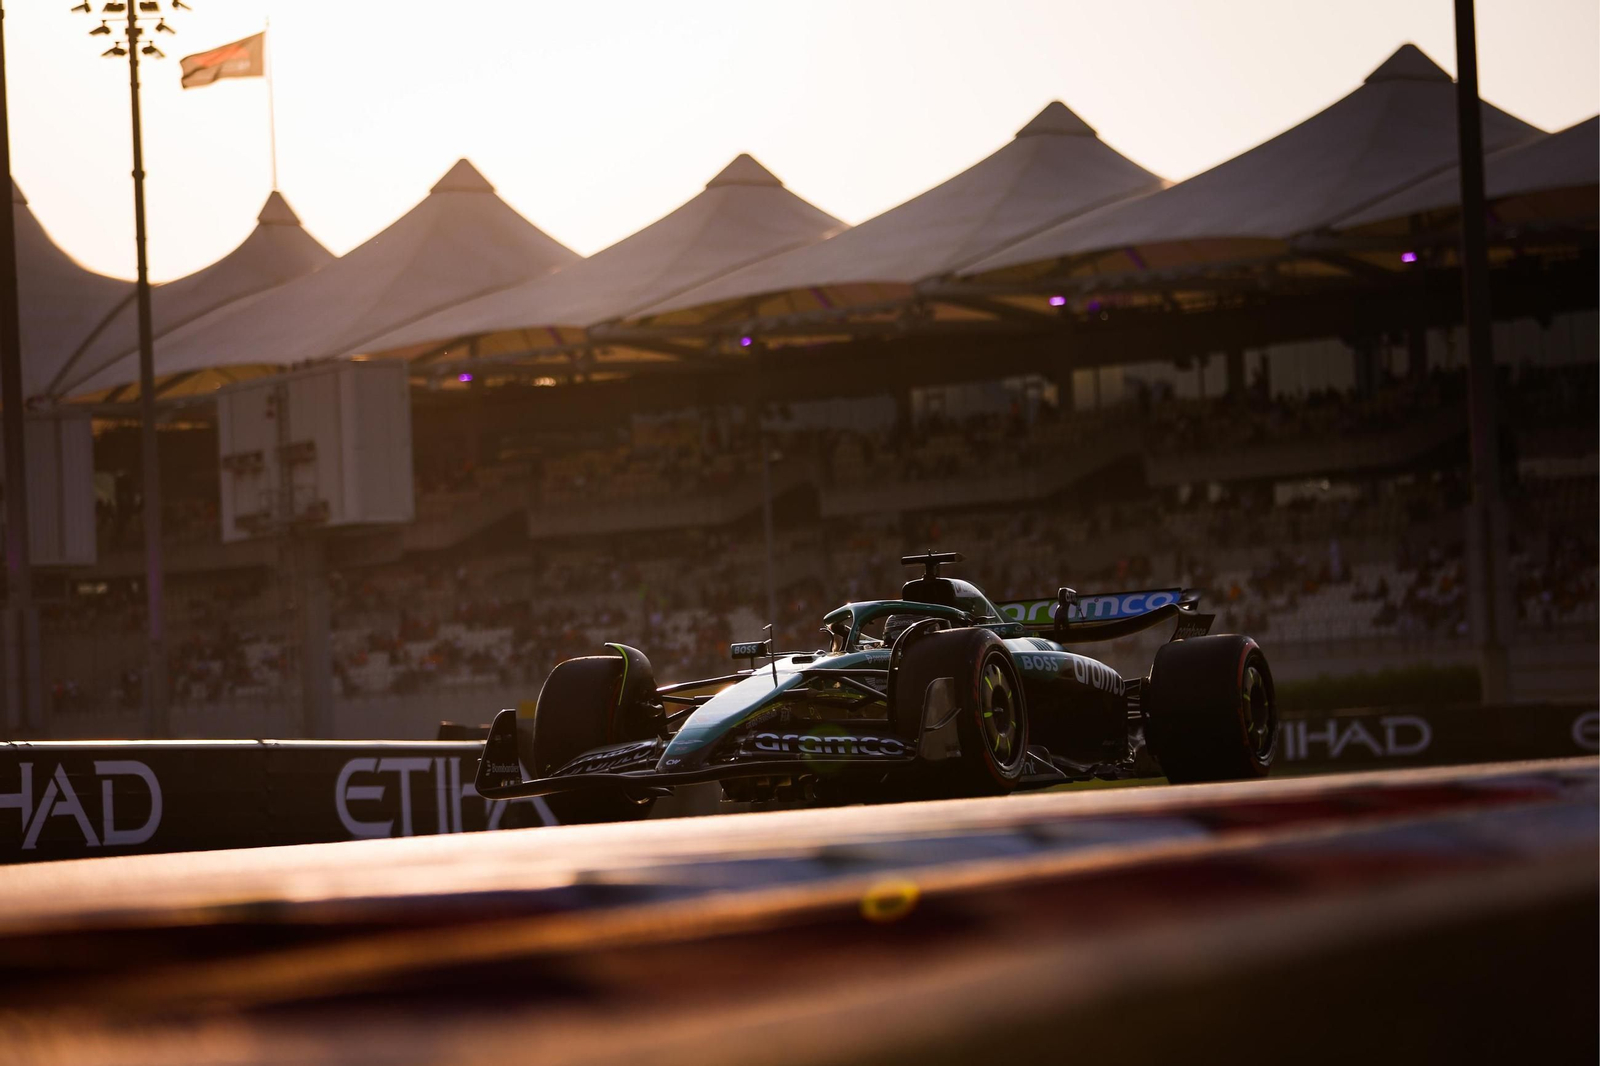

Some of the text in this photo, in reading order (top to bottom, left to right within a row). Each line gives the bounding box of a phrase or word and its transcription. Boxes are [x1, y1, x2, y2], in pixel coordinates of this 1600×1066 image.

[999, 592, 1171, 622] aramco
[734, 645, 757, 655] BOSS
[1021, 656, 1058, 671] BOSS
[1072, 656, 1126, 696] aramco
[755, 732, 904, 756] aramco
[1278, 715, 1433, 761] IHAD
[335, 756, 561, 839] ETIHA
